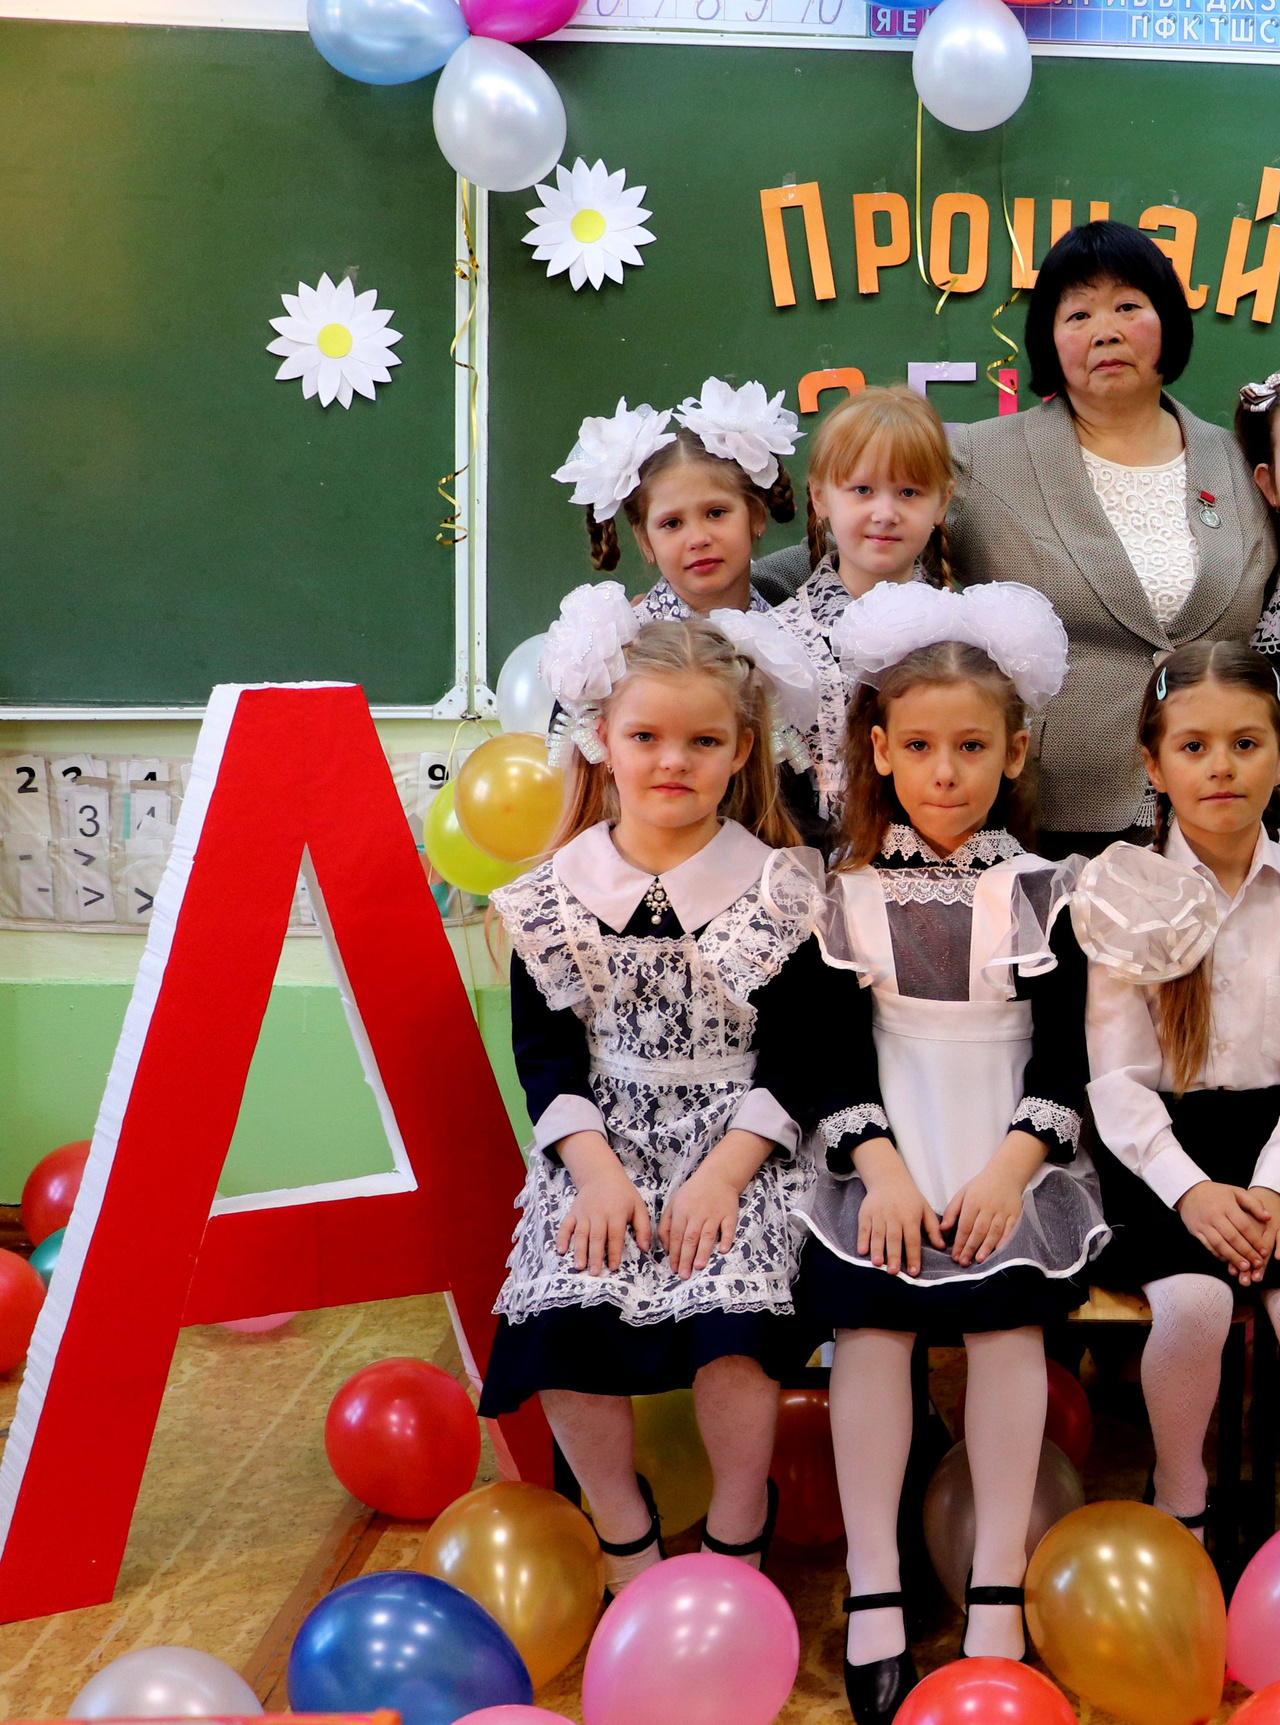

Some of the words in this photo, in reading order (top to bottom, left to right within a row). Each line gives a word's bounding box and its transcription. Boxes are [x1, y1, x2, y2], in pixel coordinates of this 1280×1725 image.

[16, 766, 39, 794] 2
[427, 763, 449, 790] 9
[78, 804, 100, 838] 3
[0, 682, 556, 1624] А
